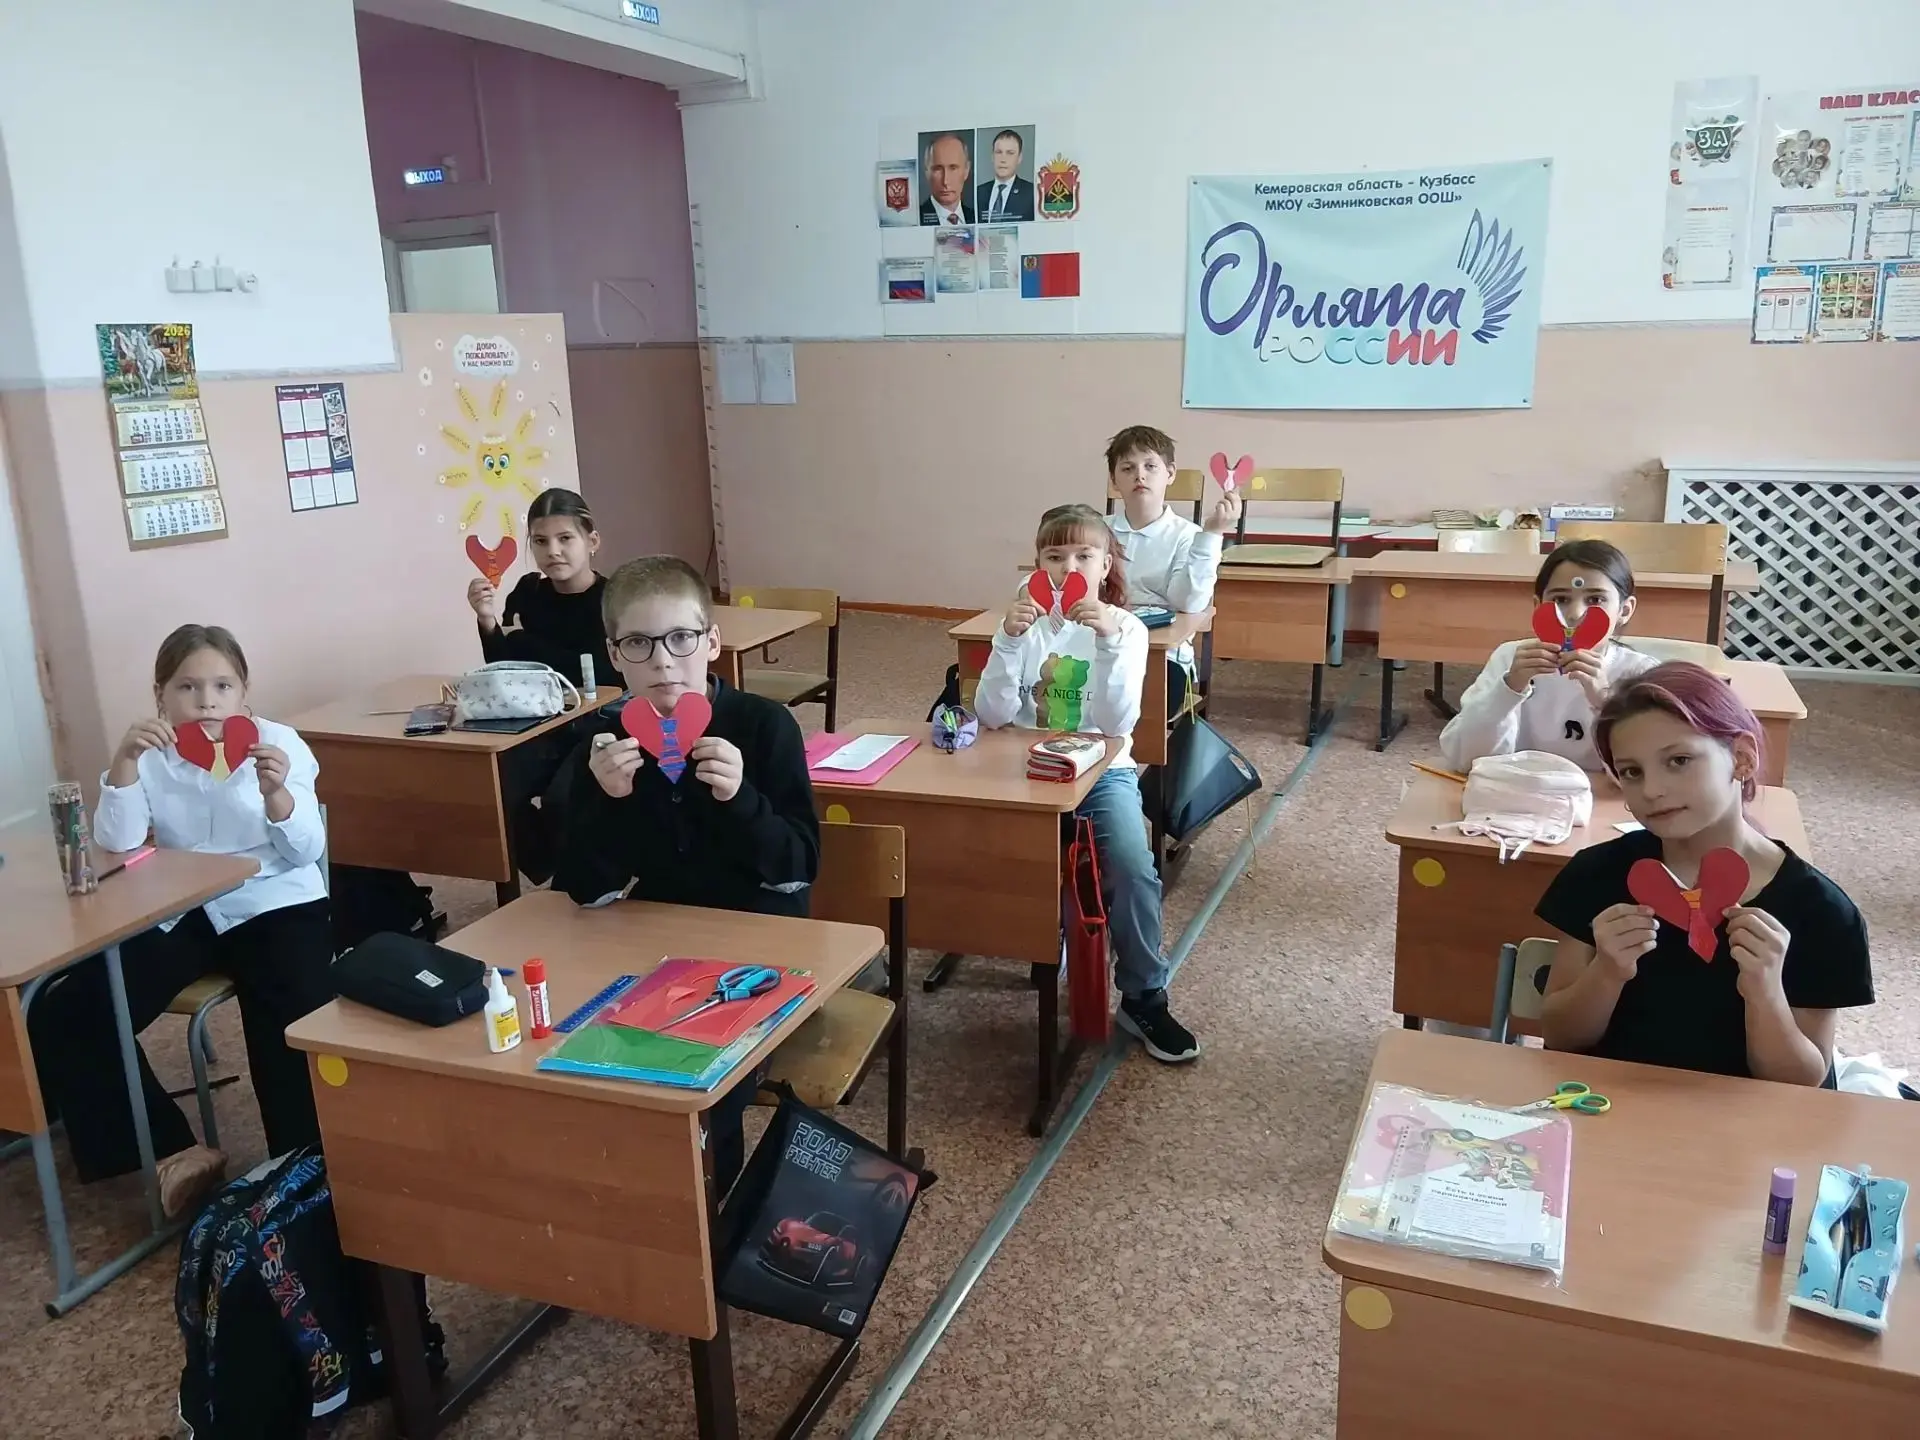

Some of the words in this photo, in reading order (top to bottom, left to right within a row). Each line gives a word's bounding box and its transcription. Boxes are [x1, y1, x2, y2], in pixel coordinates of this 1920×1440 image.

[624, 1, 658, 23] ЫХОД
[1820, 94, 1863, 109] НАШ
[405, 169, 442, 184] ЫХОД
[1255, 183, 1342, 196] Кемеровская
[1347, 179, 1403, 191] область
[1419, 173, 1476, 189] Кузбасс
[1265, 199, 1303, 212] МКОУ
[1307, 196, 1413, 209] «Зимниковская
[1418, 191, 1462, 204] ООШ»
[1200, 221, 1466, 349] Орлята
[164, 325, 191, 337] 2026
[476, 342, 497, 351] ДОБРО
[1042, 687, 1050, 697] A
[1054, 688, 1083, 701] NICE
[792, 1121, 854, 1166] ROAD
[785, 1144, 842, 1183] FIGHTER
